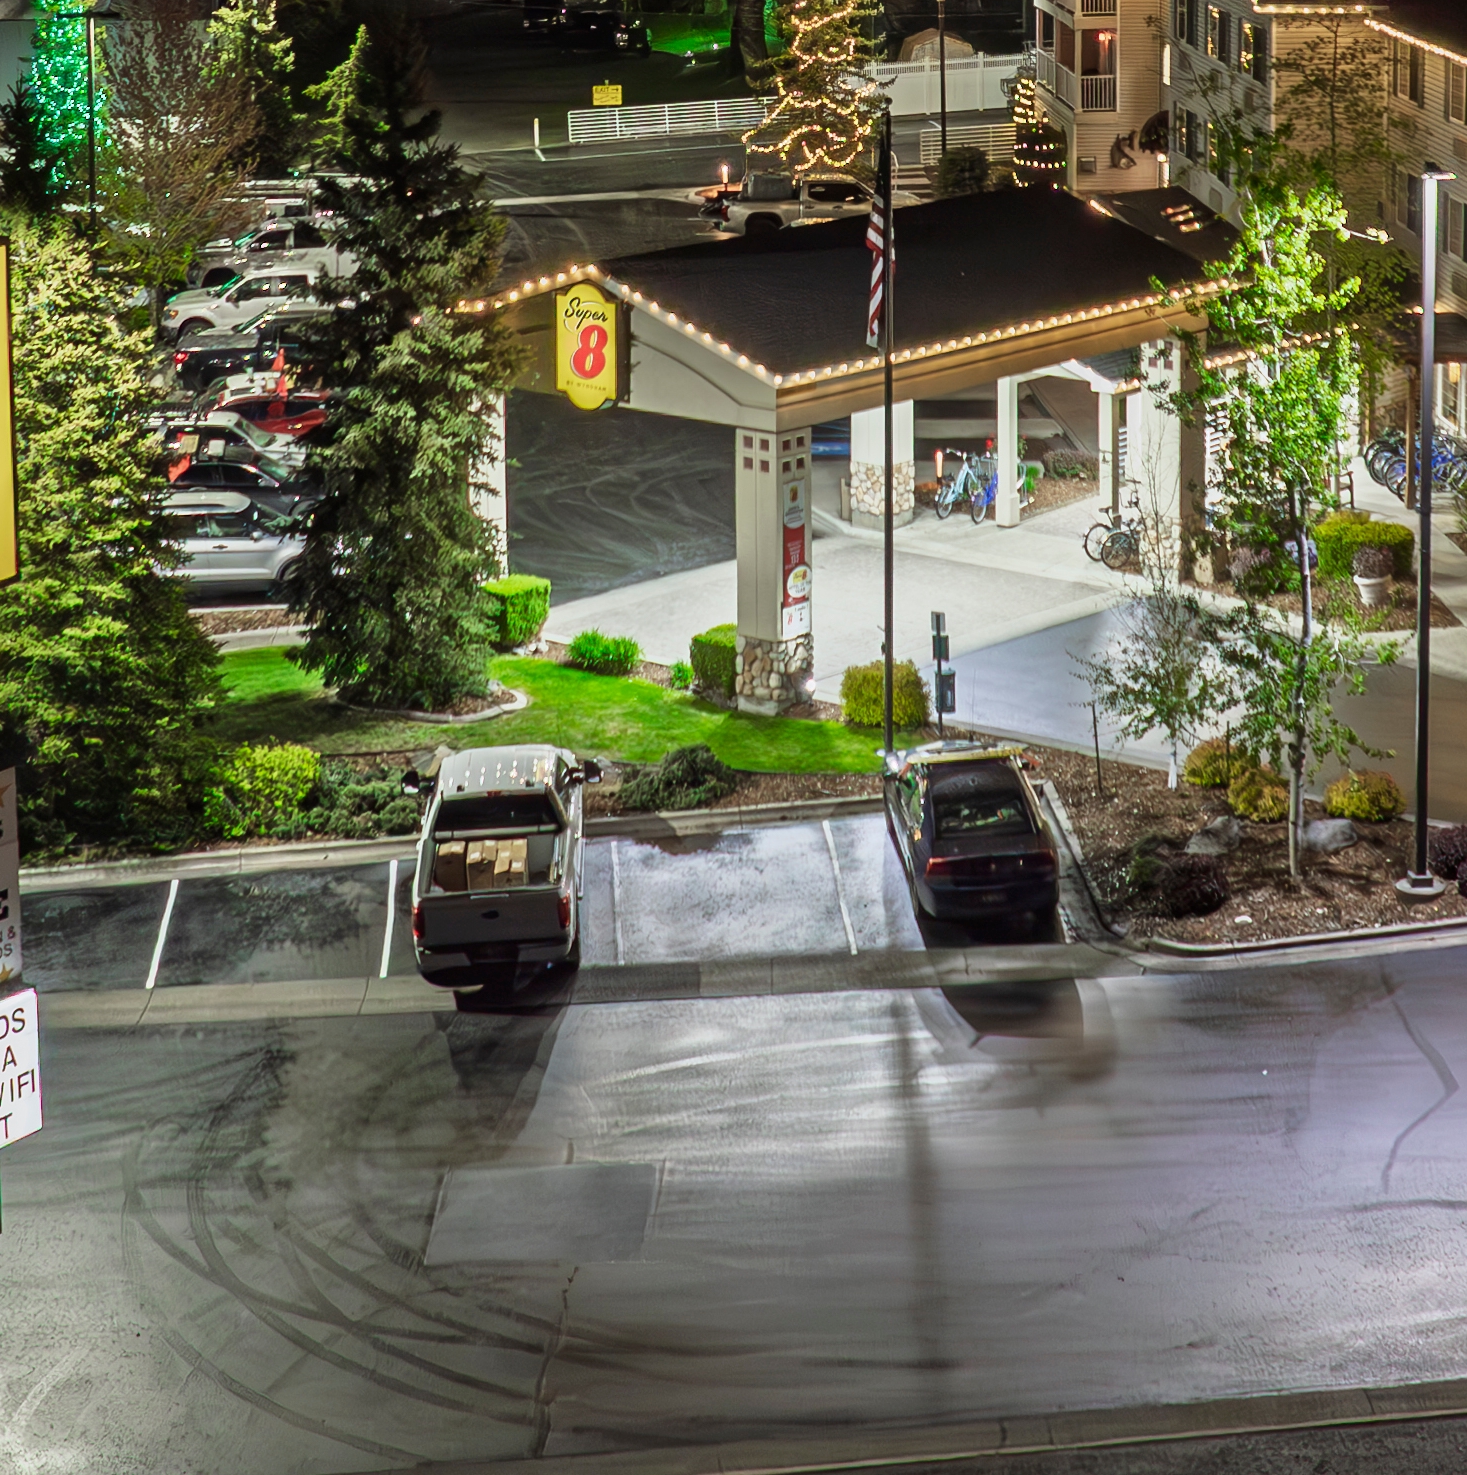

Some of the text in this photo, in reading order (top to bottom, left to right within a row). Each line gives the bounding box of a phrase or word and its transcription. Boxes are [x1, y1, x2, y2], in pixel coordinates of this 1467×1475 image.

[563, 297, 608, 331] Super
[570, 324, 608, 380] 8
[7, 925, 17, 940] &
